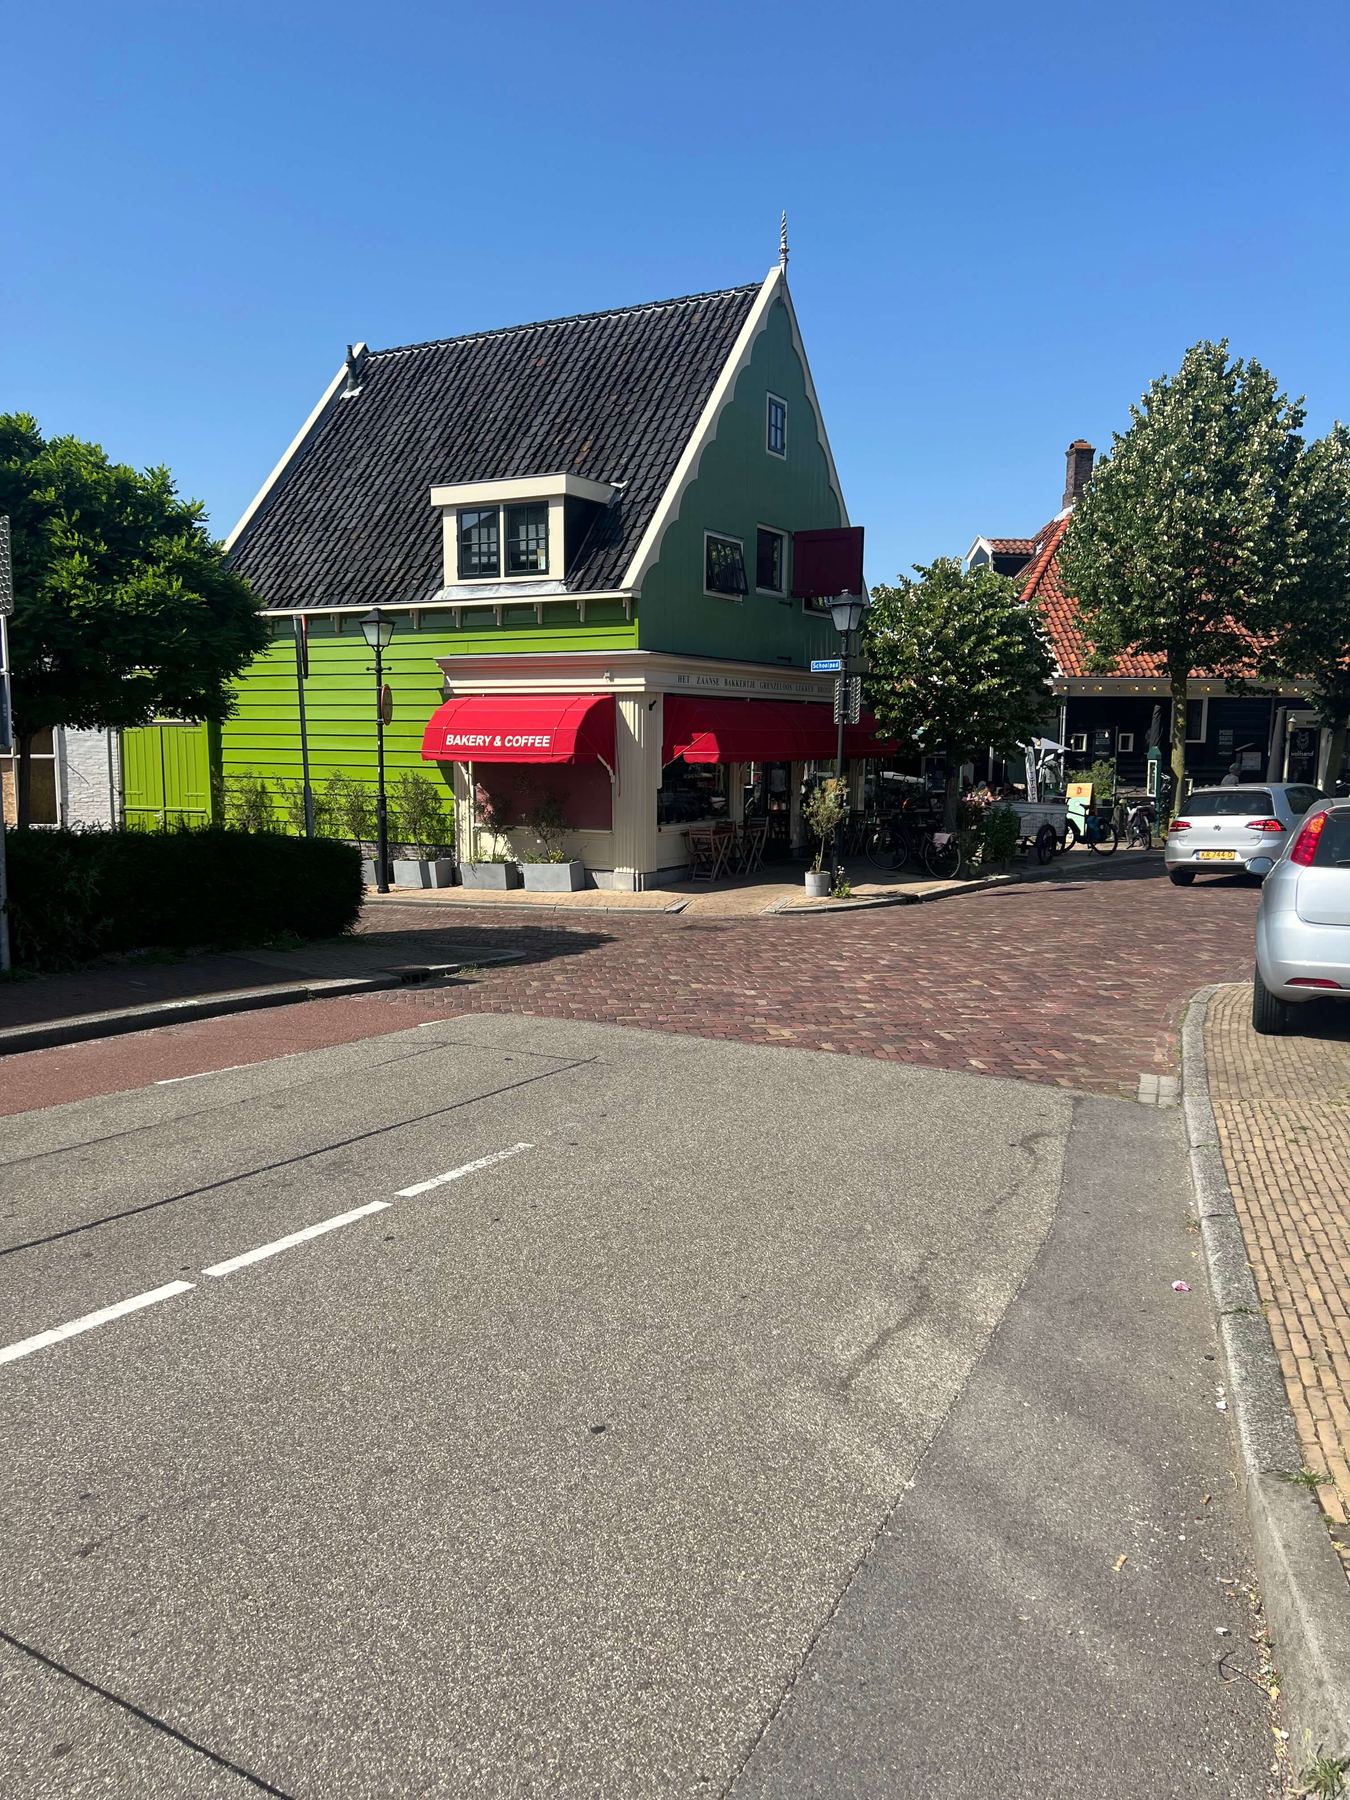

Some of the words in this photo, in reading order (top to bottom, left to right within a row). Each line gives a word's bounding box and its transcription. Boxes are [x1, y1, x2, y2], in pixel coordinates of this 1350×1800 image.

[677, 674, 690, 684] HET
[696, 676, 719, 686] ZAANSE
[446, 734, 492, 747] BAKERY
[493, 735, 502, 747] &
[504, 735, 551, 748] COFFEE
